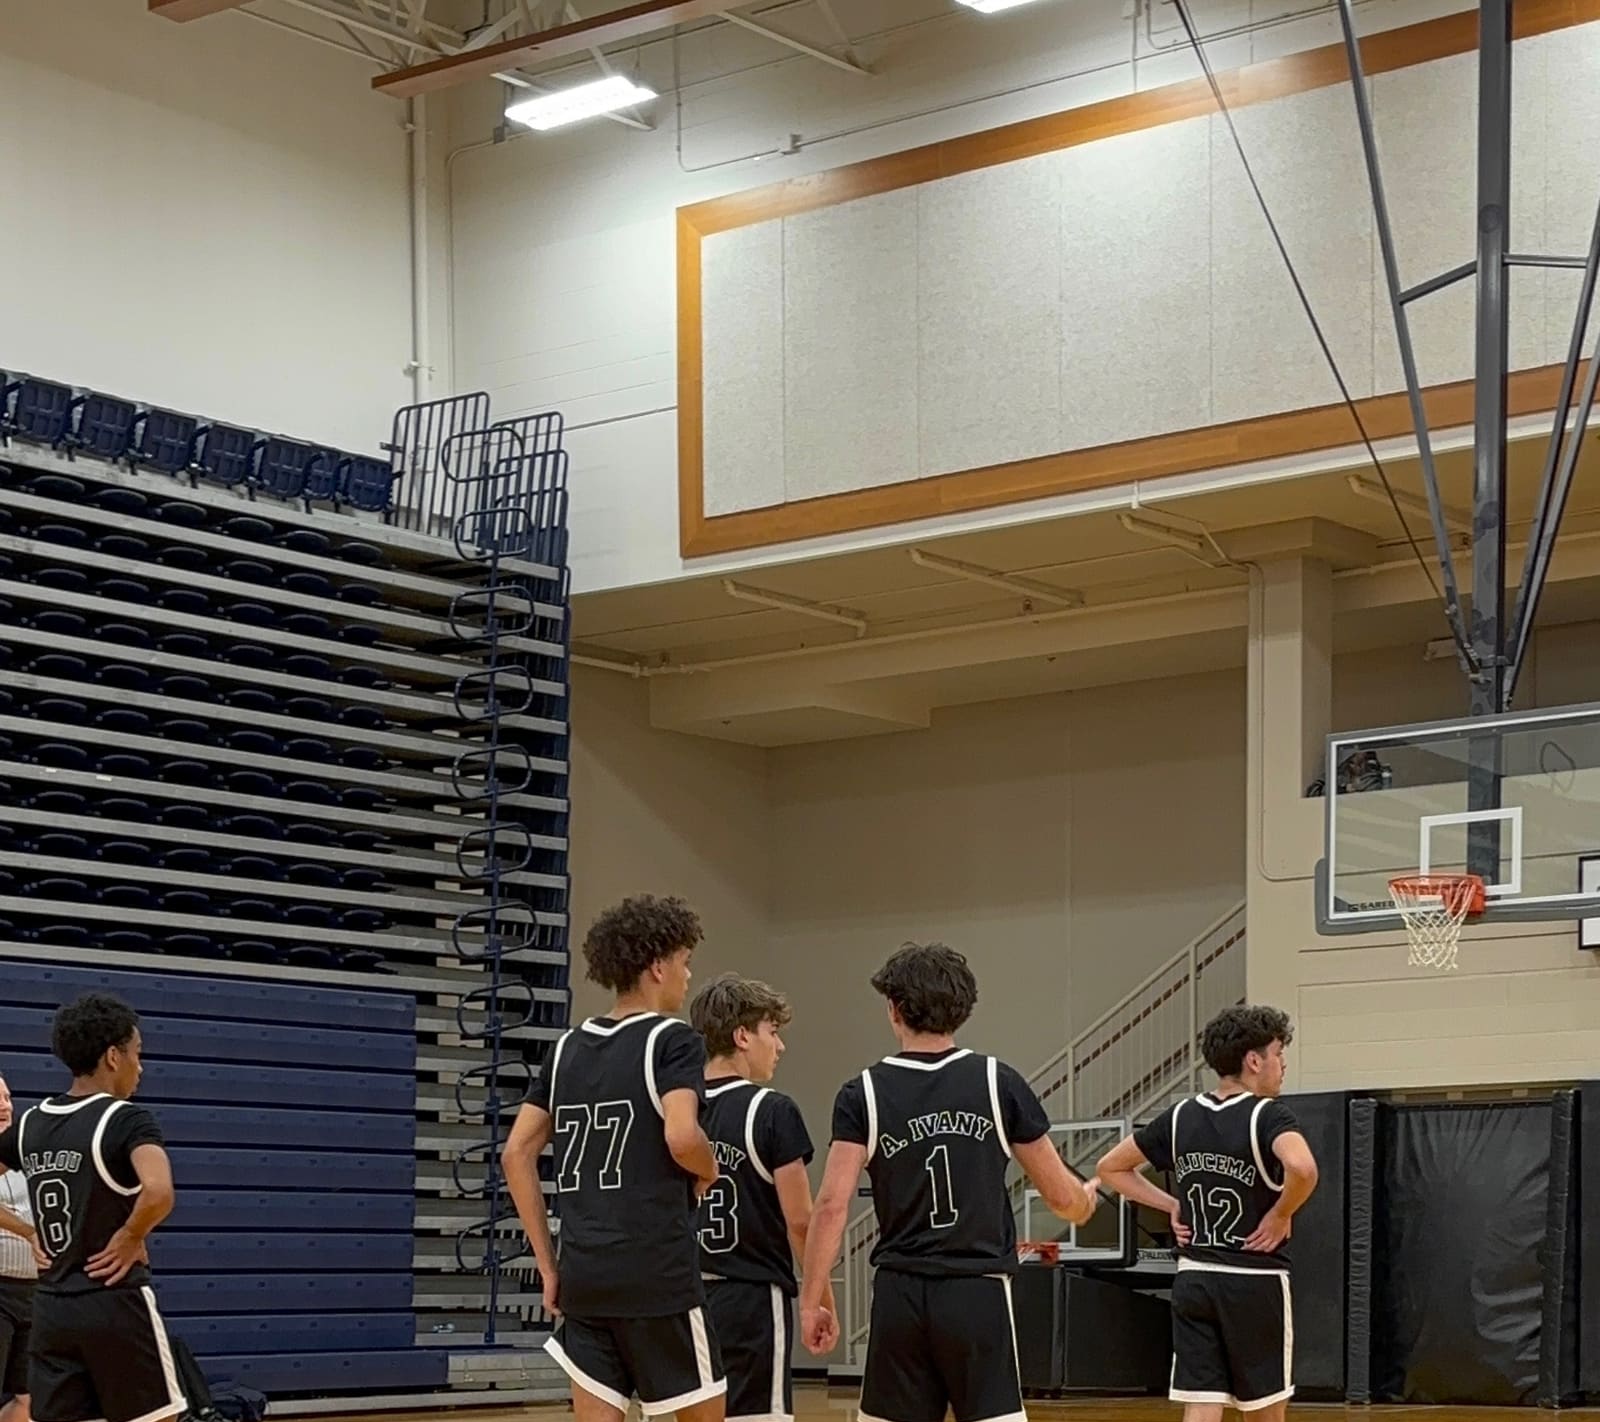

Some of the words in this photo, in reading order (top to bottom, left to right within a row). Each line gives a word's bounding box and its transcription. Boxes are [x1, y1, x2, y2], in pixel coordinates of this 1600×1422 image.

[555, 1100, 634, 1192] 77
[708, 1141, 746, 1170] NY
[880, 1133, 908, 1158] A.
[908, 1111, 993, 1142] IVANY
[36, 1178, 72, 1257] 8
[697, 1175, 739, 1253] 3
[926, 1145, 958, 1228] 1
[1187, 1183, 1247, 1247] 12
